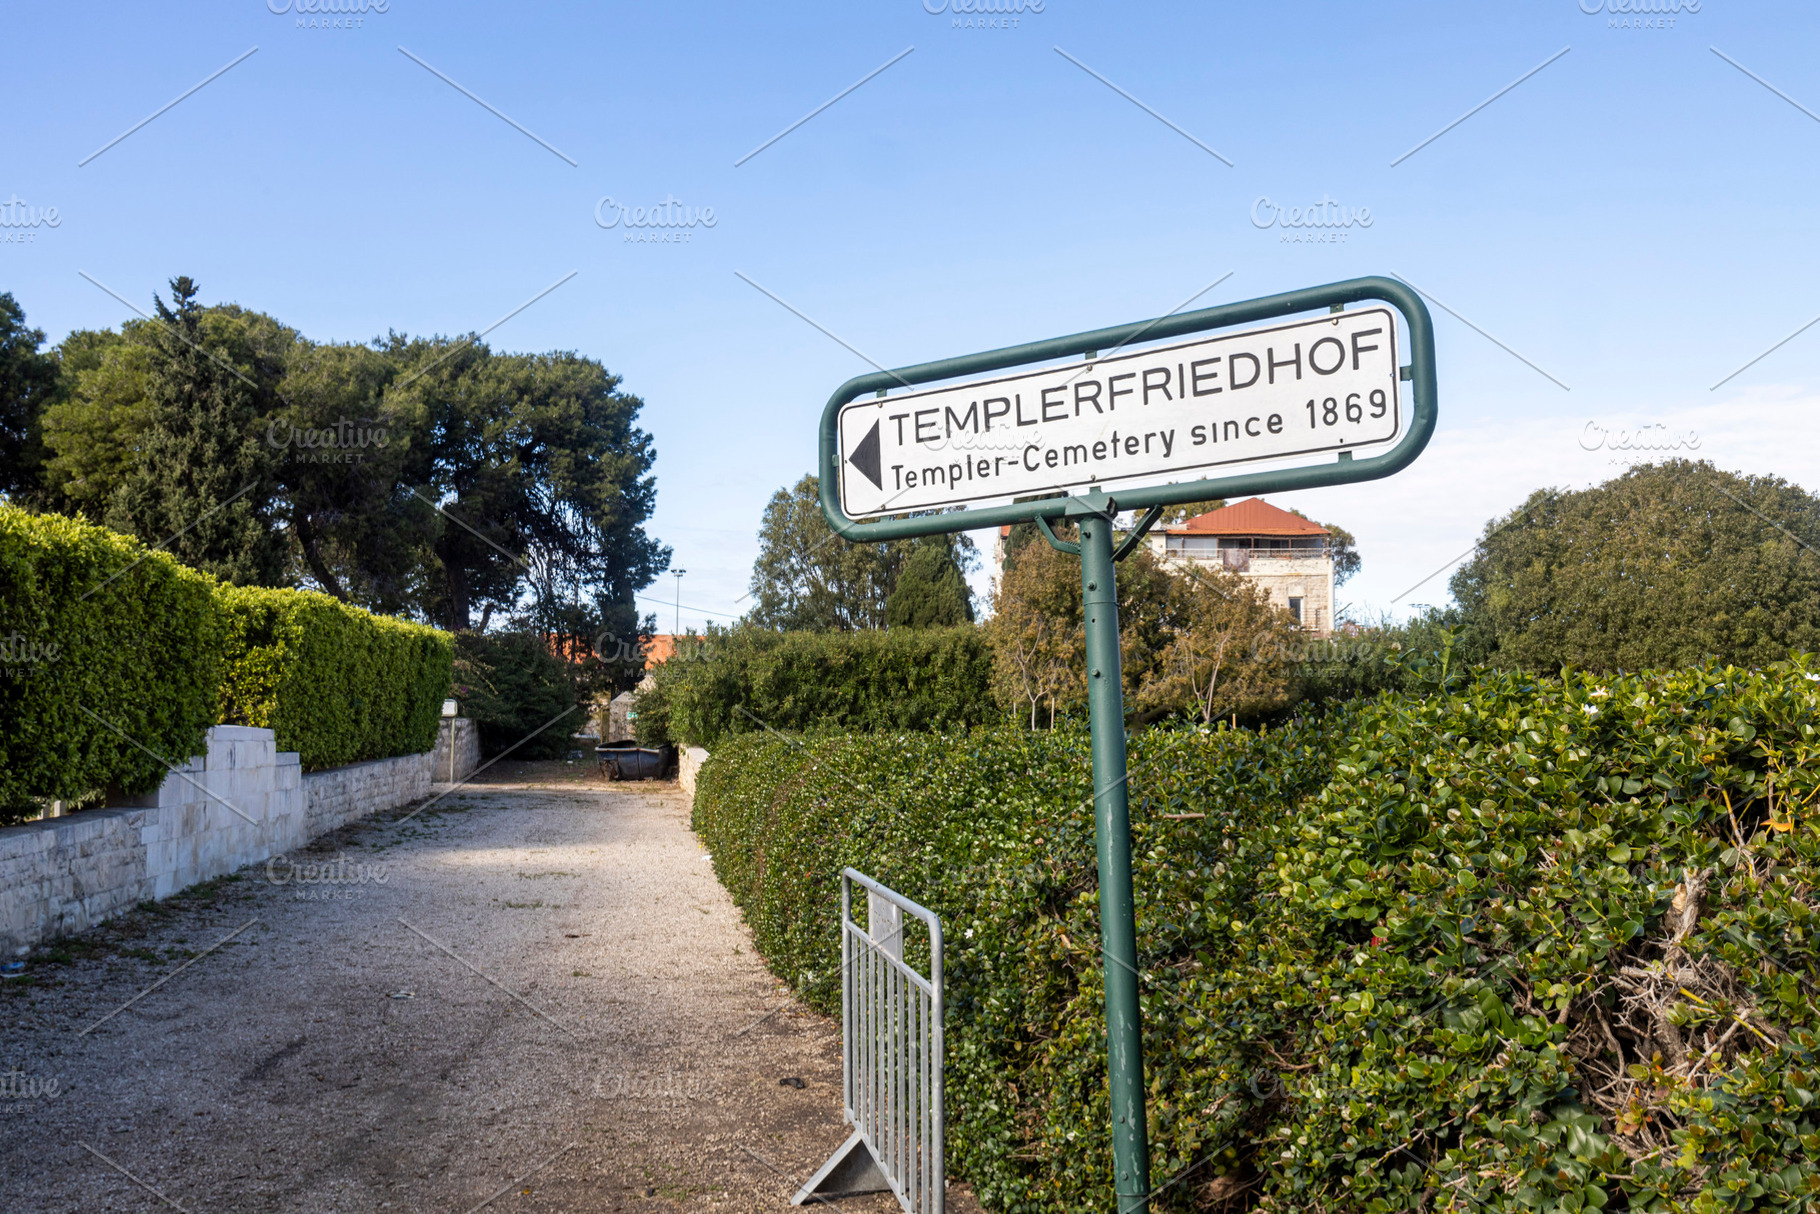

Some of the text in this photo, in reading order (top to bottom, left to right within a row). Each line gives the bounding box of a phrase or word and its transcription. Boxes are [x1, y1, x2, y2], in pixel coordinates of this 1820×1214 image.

[889, 328, 1382, 446] TEMPLERFRIEDHOF
[891, 389, 1387, 490] Templer-Cemetery since 1869
